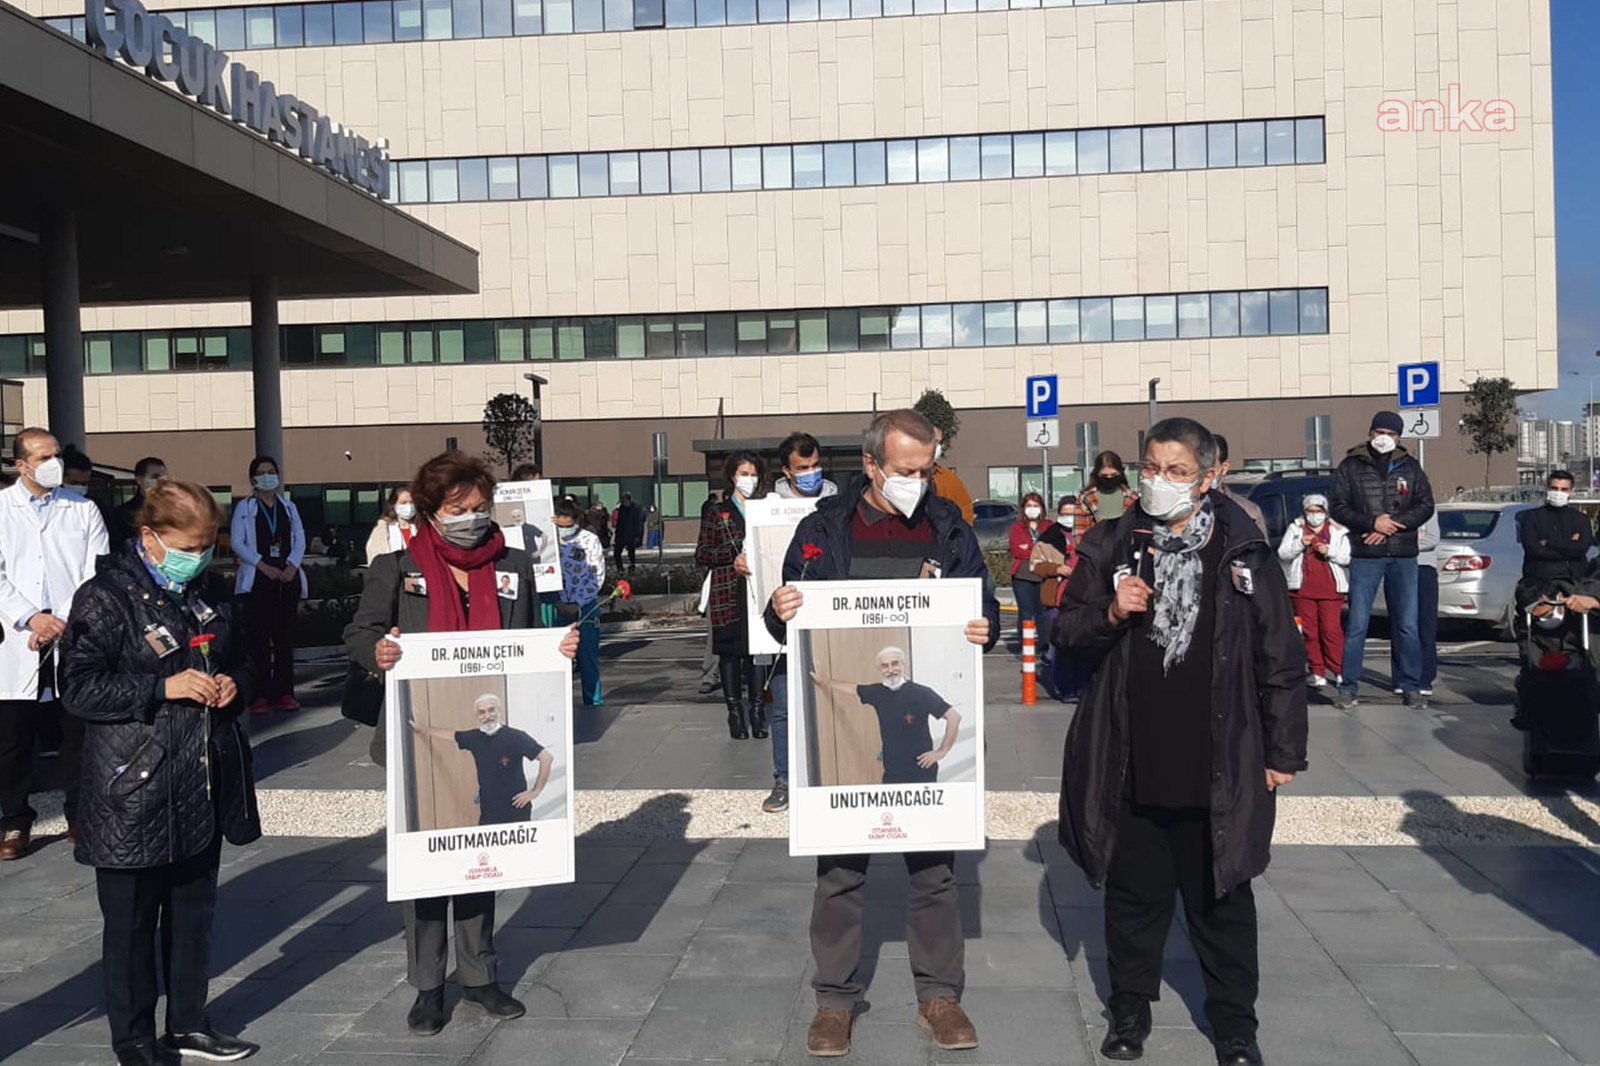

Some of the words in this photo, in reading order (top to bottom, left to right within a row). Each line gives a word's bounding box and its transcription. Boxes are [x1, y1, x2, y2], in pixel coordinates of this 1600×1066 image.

[85, 0, 231, 115] ÇOCUK
[230, 62, 390, 200] HASTANESİ
[1032, 380, 1051, 414] P
[1406, 367, 1430, 403] P
[832, 597, 852, 611] DR.
[854, 595, 894, 610] ADNAN
[897, 592, 930, 611] ÇETİN
[431, 647, 451, 661] DR.
[453, 646, 491, 660] ADNAN
[493, 641, 525, 661] ÇETİN
[830, 785, 944, 809] UNUTMAYACAĞIZ
[428, 825, 538, 853] UNUTMAYACAĞIZ
